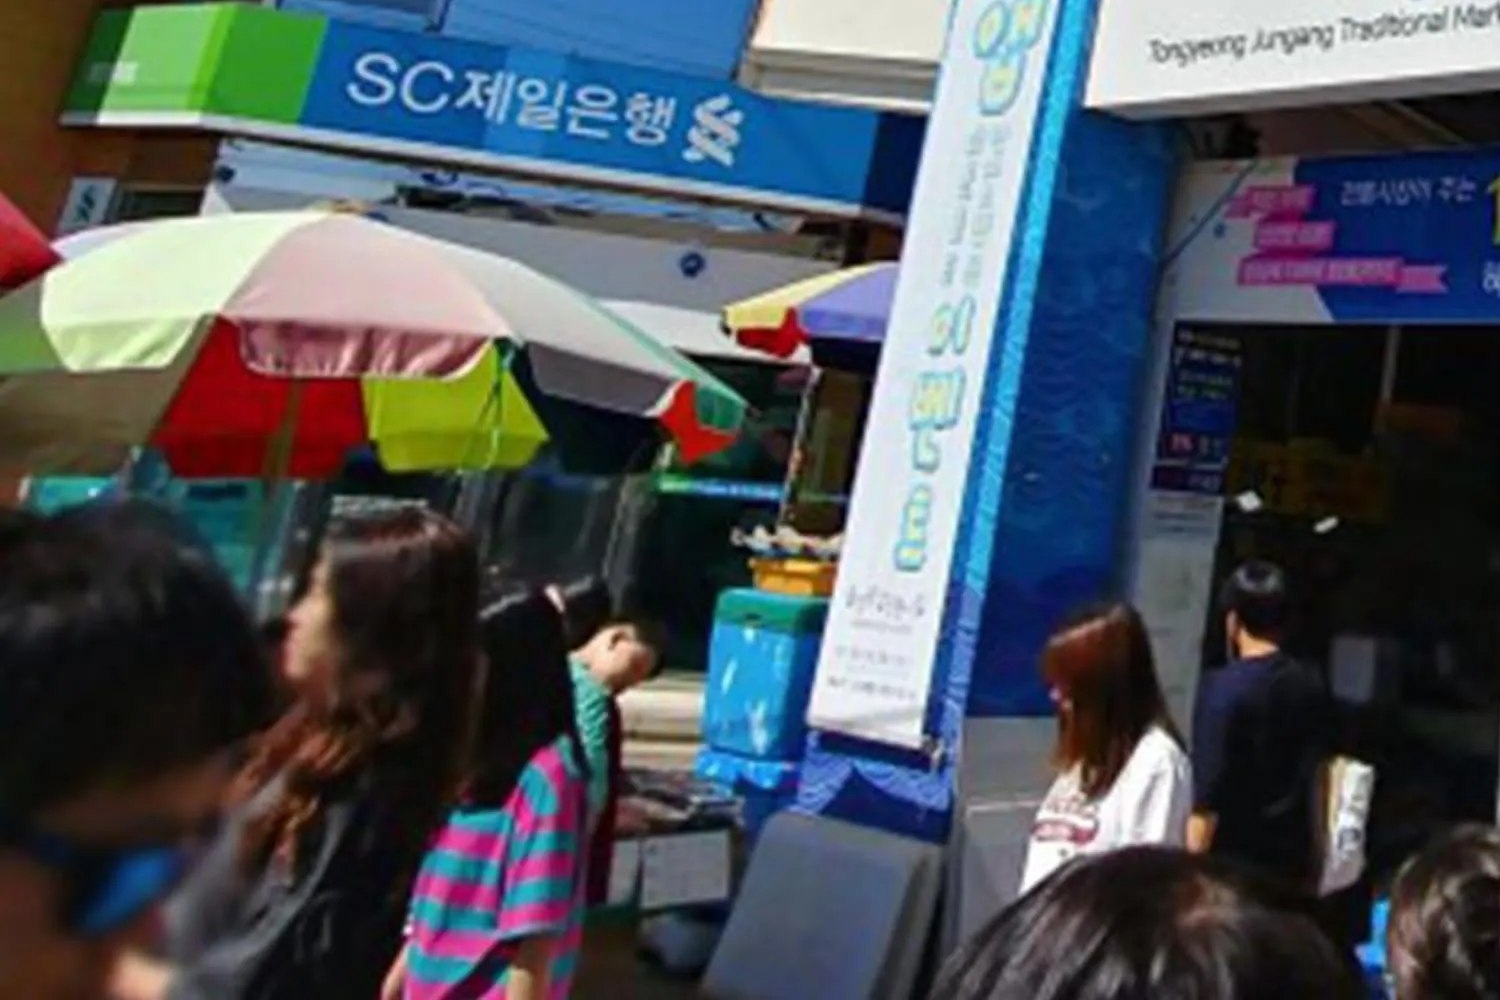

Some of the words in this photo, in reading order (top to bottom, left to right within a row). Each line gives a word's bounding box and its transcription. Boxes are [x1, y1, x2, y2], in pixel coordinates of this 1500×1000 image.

[1149, 32, 1248, 67] Tongyeong
[1251, 24, 1335, 54] Jungang
[1340, 6, 1449, 42] Traditional
[347, 51, 676, 146] SC제일은행
